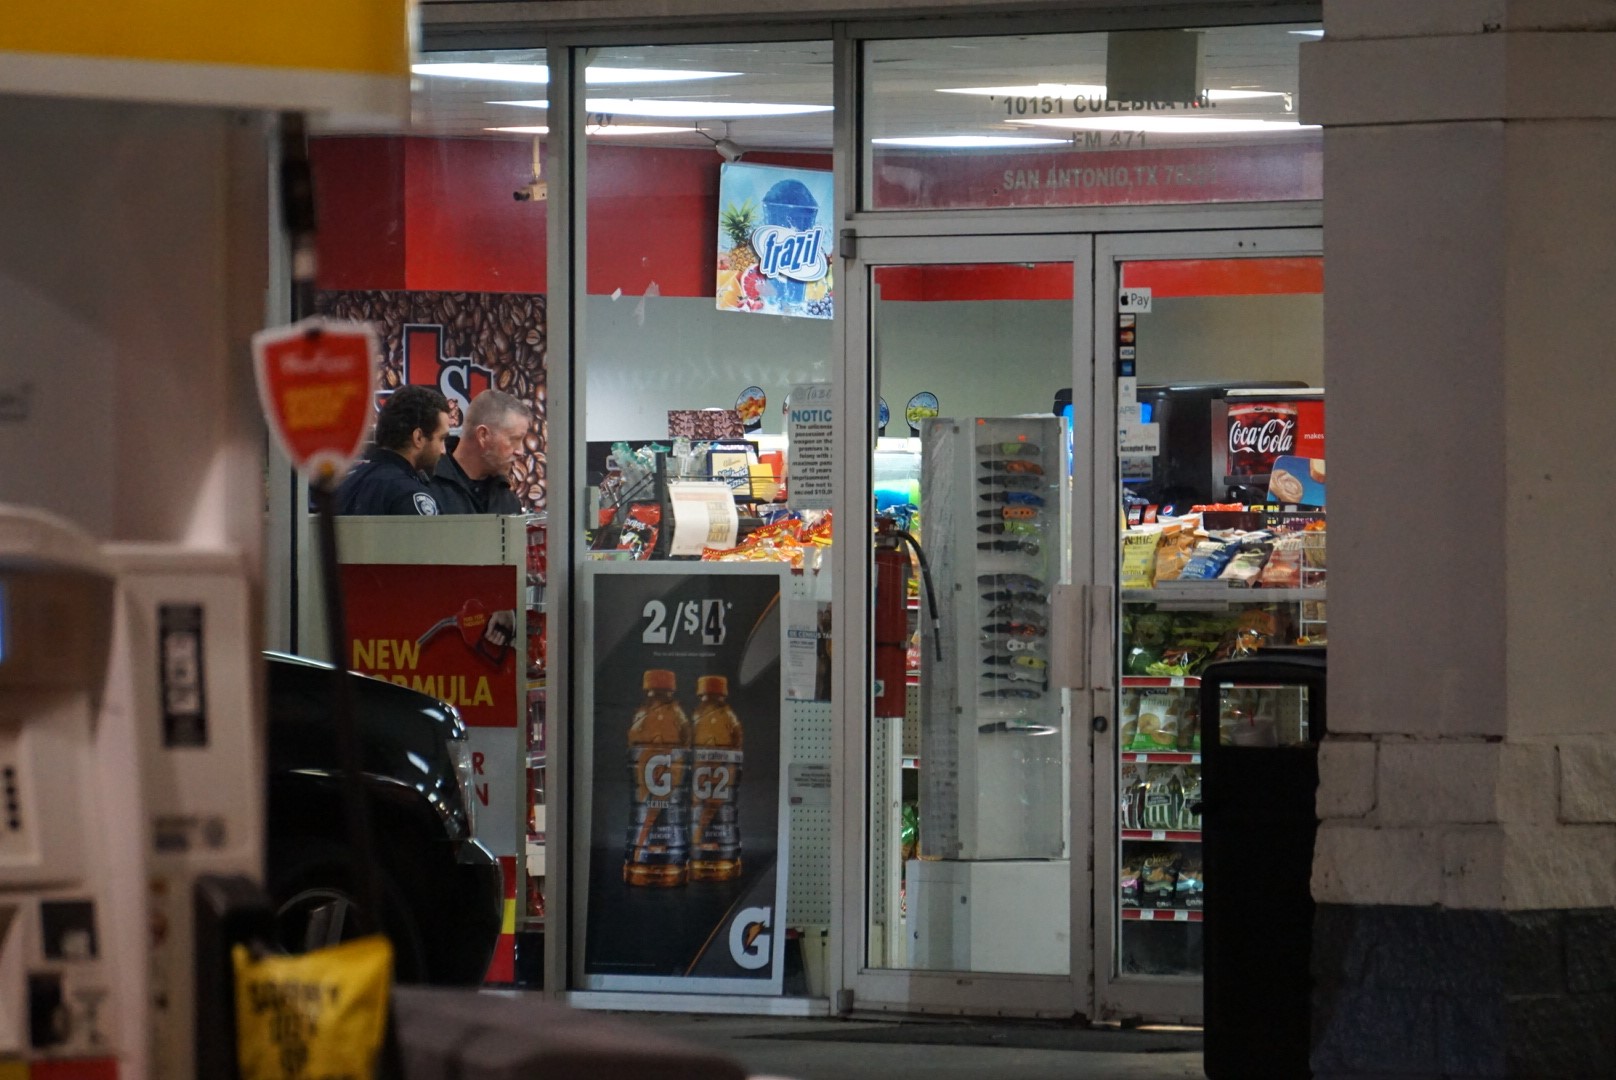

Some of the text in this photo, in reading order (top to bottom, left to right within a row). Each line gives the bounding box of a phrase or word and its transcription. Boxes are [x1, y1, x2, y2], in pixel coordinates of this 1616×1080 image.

[1003, 96, 1064, 115] 10151
[1072, 130, 1146, 147] FM 471
[1003, 169, 1040, 190] SAN
[762, 229, 821, 275] frazil
[1130, 293, 1150, 309] Pay
[791, 409, 833, 423] NOTIC
[1229, 418, 1294, 454] Coca-Cola
[1303, 432, 1325, 440] makes
[352, 638, 421, 670] NEW
[644, 754, 672, 797] G
[692, 766, 730, 800] G2
[728, 906, 772, 970] G
